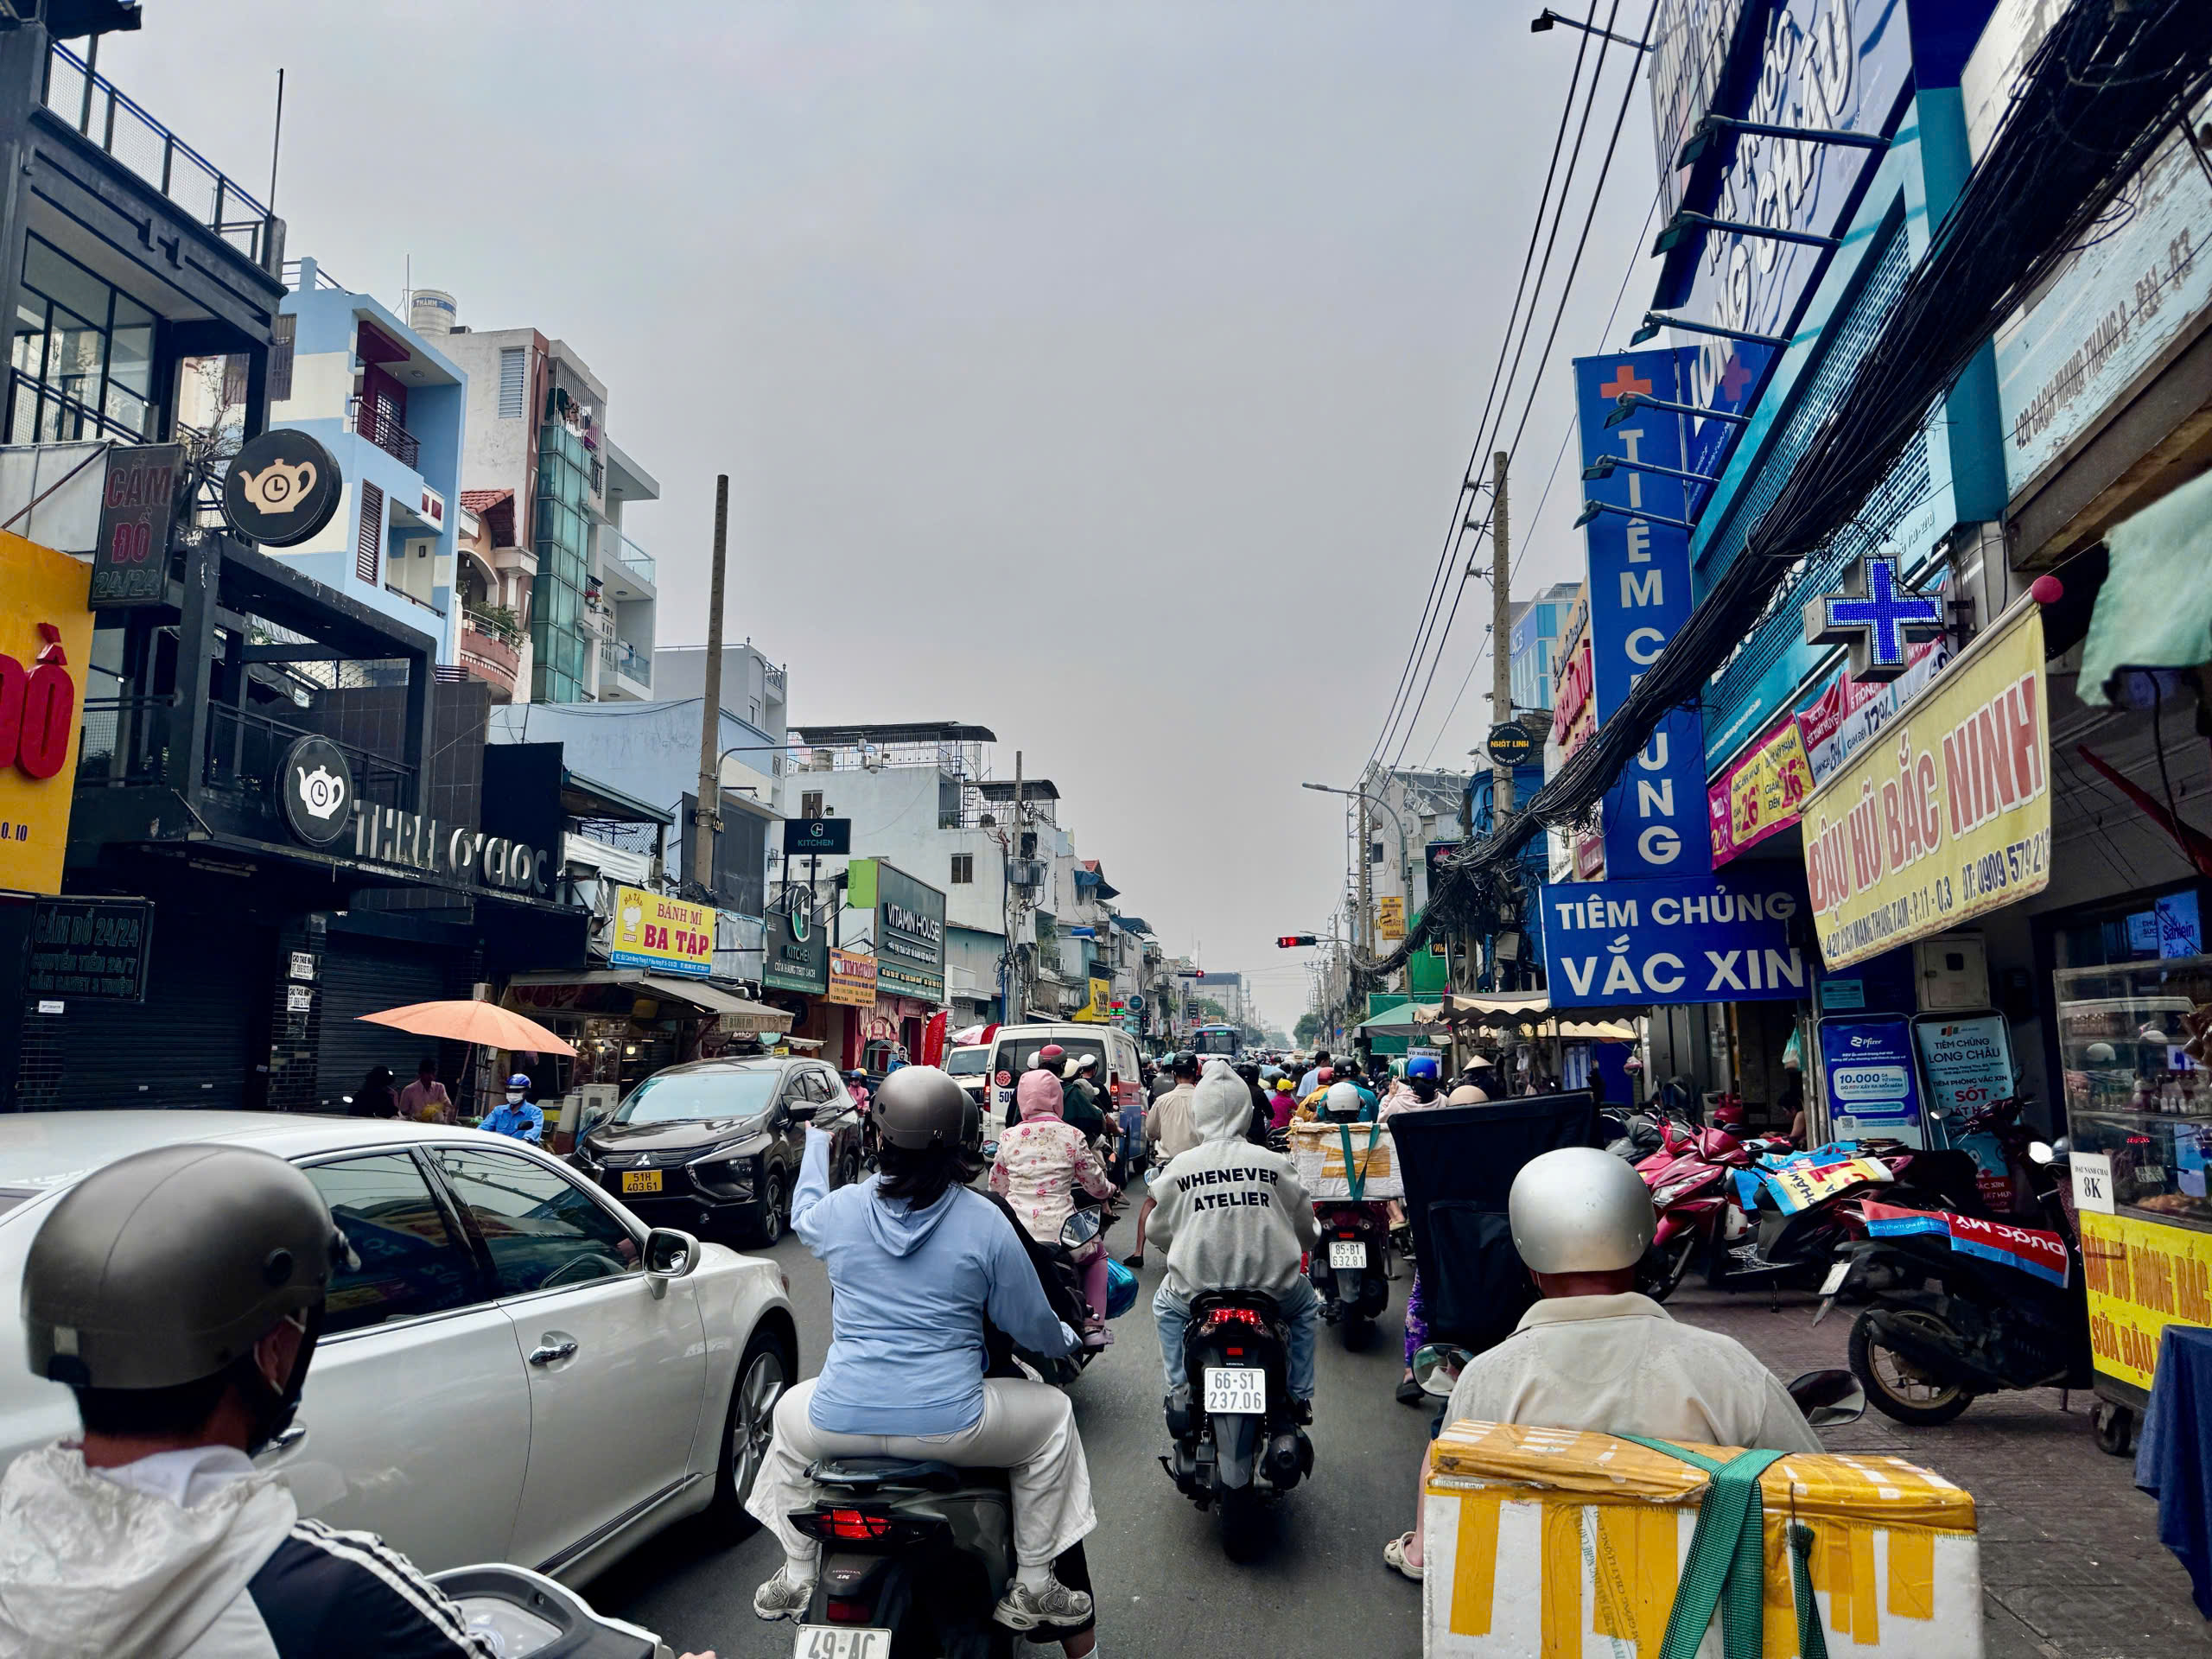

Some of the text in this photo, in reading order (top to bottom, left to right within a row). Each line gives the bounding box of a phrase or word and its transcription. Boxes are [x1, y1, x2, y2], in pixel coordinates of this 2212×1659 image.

[1690, 244, 1751, 437] LONG
[1755, 0, 1853, 275] CHÂU
[95, 569, 161, 597] 24/24
[1618, 429, 1681, 865] TIÊM CNG
[1490, 740, 1511, 749] NHẬT
[1777, 754, 1806, 810] 26%
[1807, 814, 1851, 926] ĐẬU
[1848, 775, 1885, 893] HŨ
[1881, 728, 1942, 874] BẮC
[1942, 670, 2046, 841] NINH
[797, 839, 835, 848] KITCHEN
[1977, 849, 2006, 894] 0909
[2006, 840, 2032, 884] 579
[657, 901, 702, 926] BÁNH MÌ
[1555, 885, 1797, 931] TIÊM CHỦNG
[94, 917, 139, 947] 24/24
[887, 901, 941, 943] VITAMIN HOUSE
[643, 923, 709, 961] BA TẬP
[785, 944, 812, 963] KITCHEN
[1560, 933, 1805, 997] VẮC XIN
[1863, 1037, 1883, 1048] Pfizer
[1934, 1037, 1990, 1050] TIÊM CHỦNG
[1928, 1046, 2001, 1064] LONG CHÂU
[1839, 1073, 1880, 1084] 10.000
[1955, 1084, 1988, 1103] SỐT
[626, 1182, 658, 1192] 403.61
[633, 1172, 652, 1182] 51H
[1177, 1167, 1279, 1193] WHENEVER
[2083, 1176, 2102, 1199] 8K
[1194, 1192, 1269, 1212] ATELIER
[1335, 1244, 1360, 1255] 85-B1
[1332, 1255, 1363, 1267] 632.81
[2091, 1311, 2155, 1381] SỮA ĐẬU
[1215, 1372, 1254, 1390] 66-S1
[1209, 1391, 1262, 1410] 237.06
